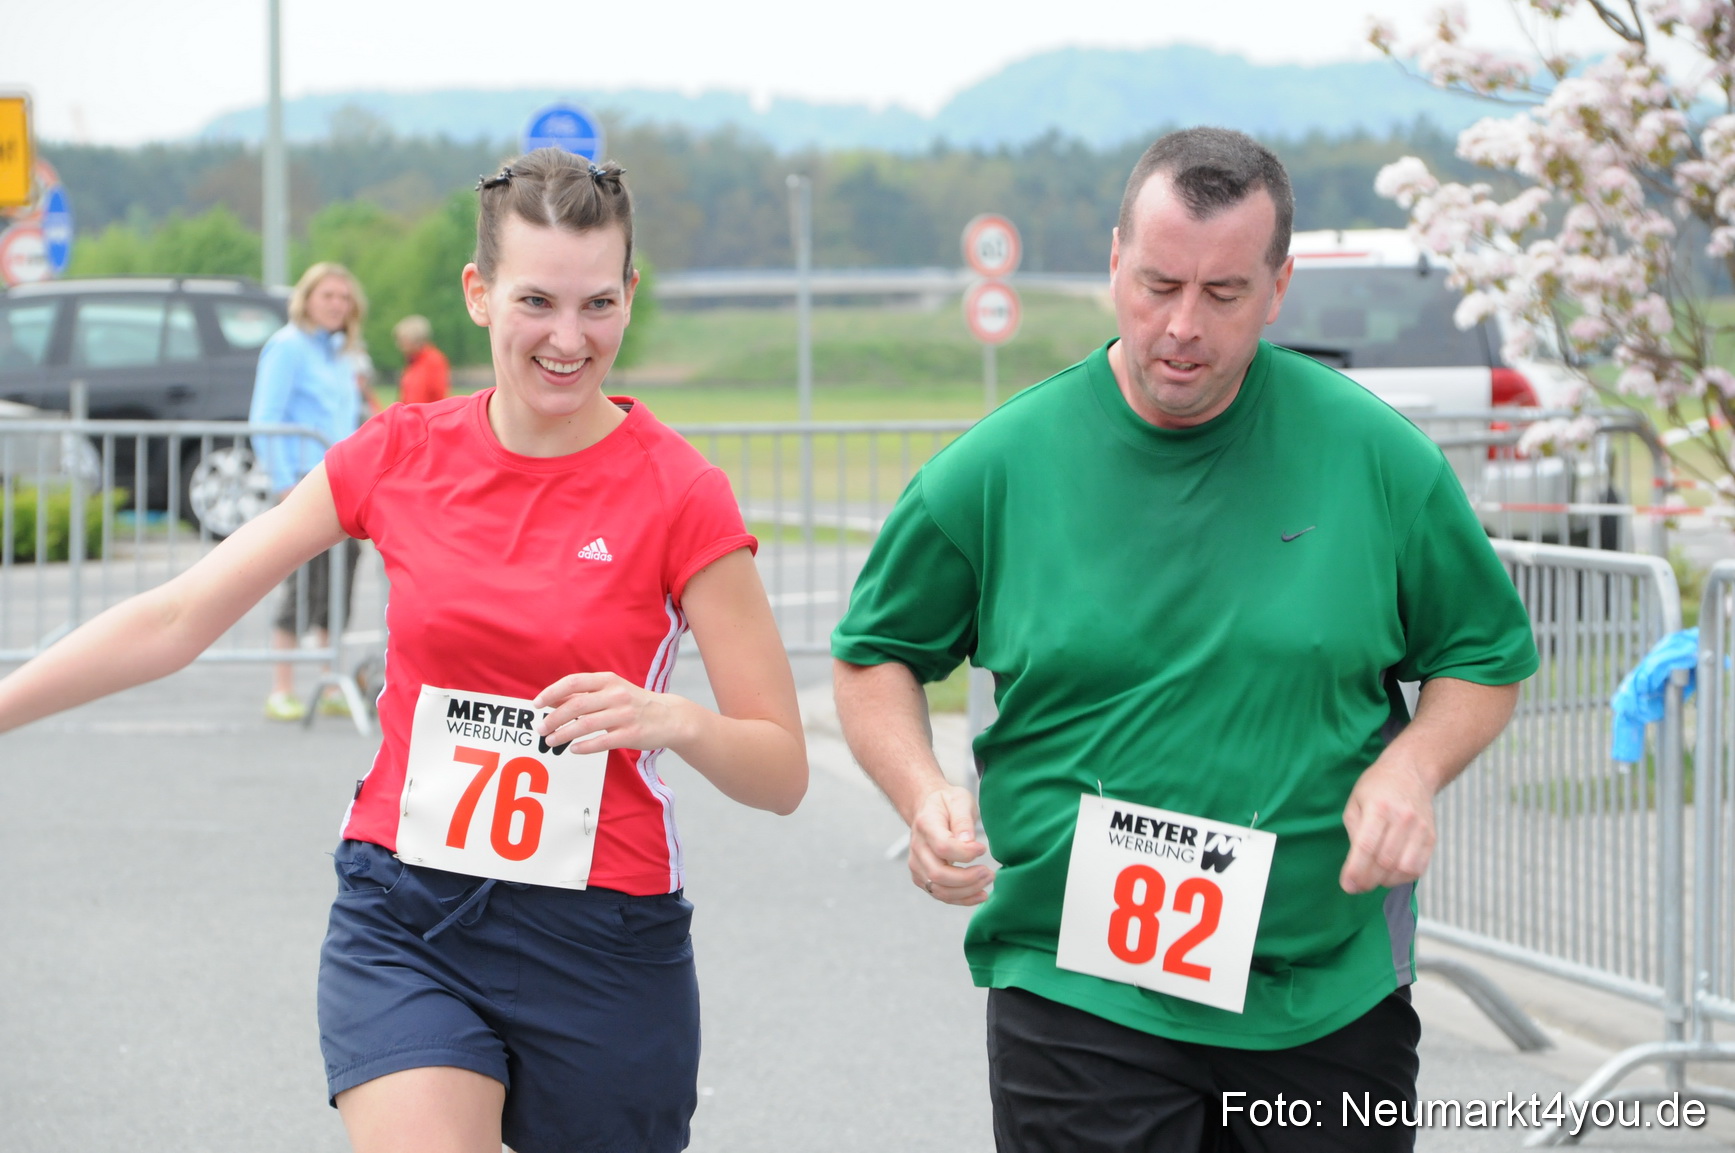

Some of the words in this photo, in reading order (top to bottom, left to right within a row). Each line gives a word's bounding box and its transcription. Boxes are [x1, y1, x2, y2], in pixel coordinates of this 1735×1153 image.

[577, 550, 613, 562] adidas
[446, 698, 535, 731] MEYER
[446, 719, 533, 746] WERBUNG
[445, 745, 549, 862] 76
[1109, 810, 1199, 847] MEYER
[1108, 831, 1195, 864] WERBUNG
[1107, 864, 1224, 982] 82
